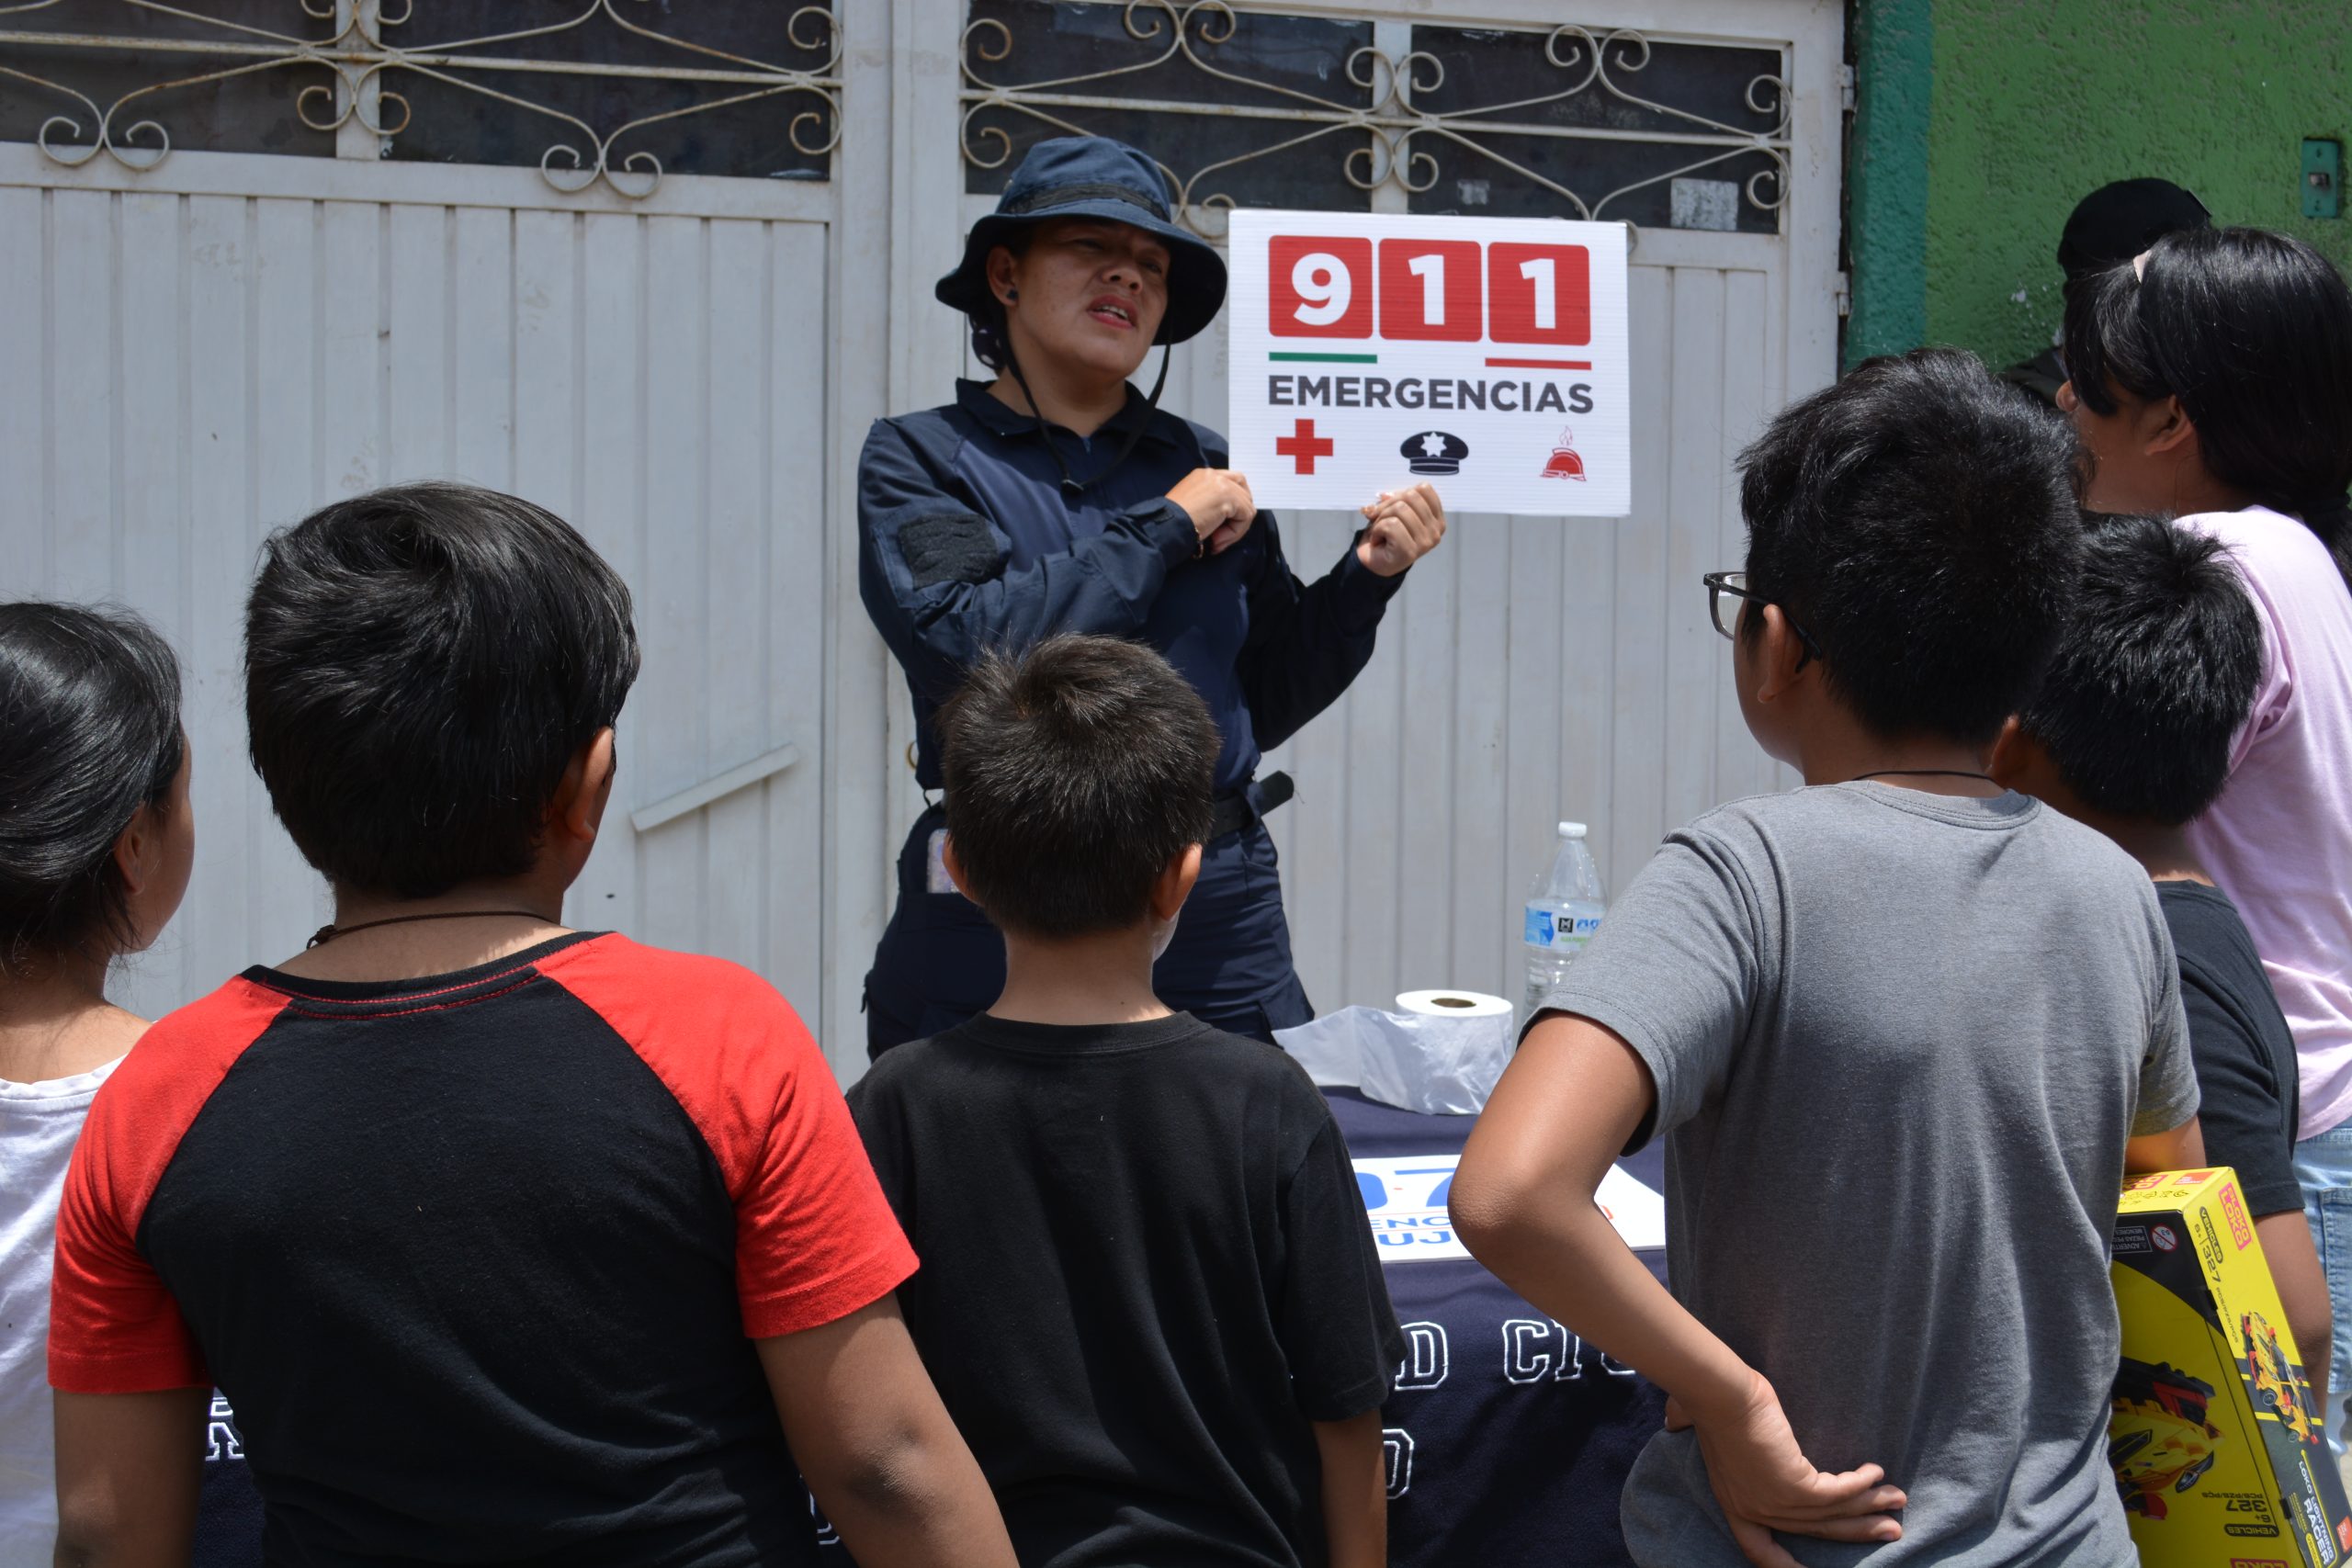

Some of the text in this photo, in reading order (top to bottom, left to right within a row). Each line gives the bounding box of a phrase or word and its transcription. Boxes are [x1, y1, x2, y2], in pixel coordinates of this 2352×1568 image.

[1269, 374, 1594, 414] EMERGENCIAS
[2200, 1209, 2222, 1261] VEHICLES
[2221, 1193, 2245, 1247] LOKO
[2201, 1246, 2222, 1282] 327
[2225, 1499, 2267, 1513] 327
[2255, 1514, 2271, 1523] 6+
[2299, 1461, 2335, 1560] LOKO LIGHTNING
[2227, 1526, 2277, 1535] VEHICLES
[2304, 1497, 2330, 1565] RACER
